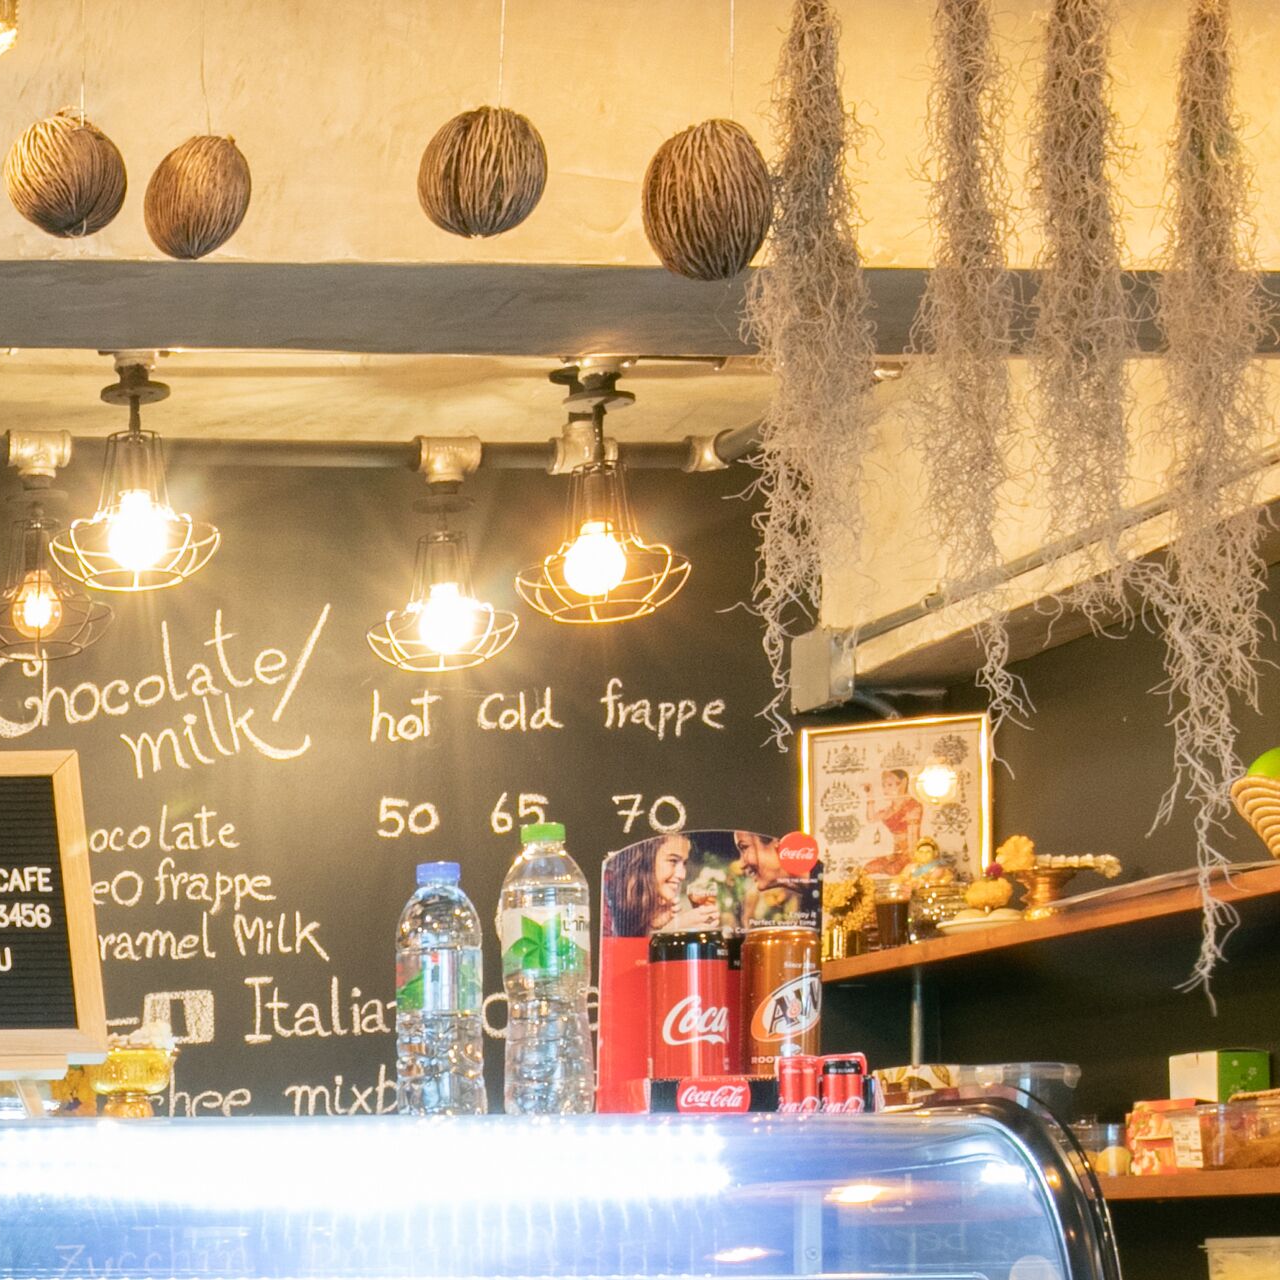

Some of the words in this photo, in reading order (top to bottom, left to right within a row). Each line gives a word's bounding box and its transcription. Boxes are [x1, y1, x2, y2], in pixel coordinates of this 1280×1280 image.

[121, 692, 311, 780] milk
[369, 688, 442, 743] hot
[600, 675, 726, 742] frappe
[90, 804, 240, 852] ocolate
[377, 796, 440, 839] 50
[490, 793, 547, 835] 65
[611, 795, 686, 833] 70
[155, 857, 276, 915] frappe
[99, 911, 216, 961] ramel
[234, 911, 330, 962] Milk
